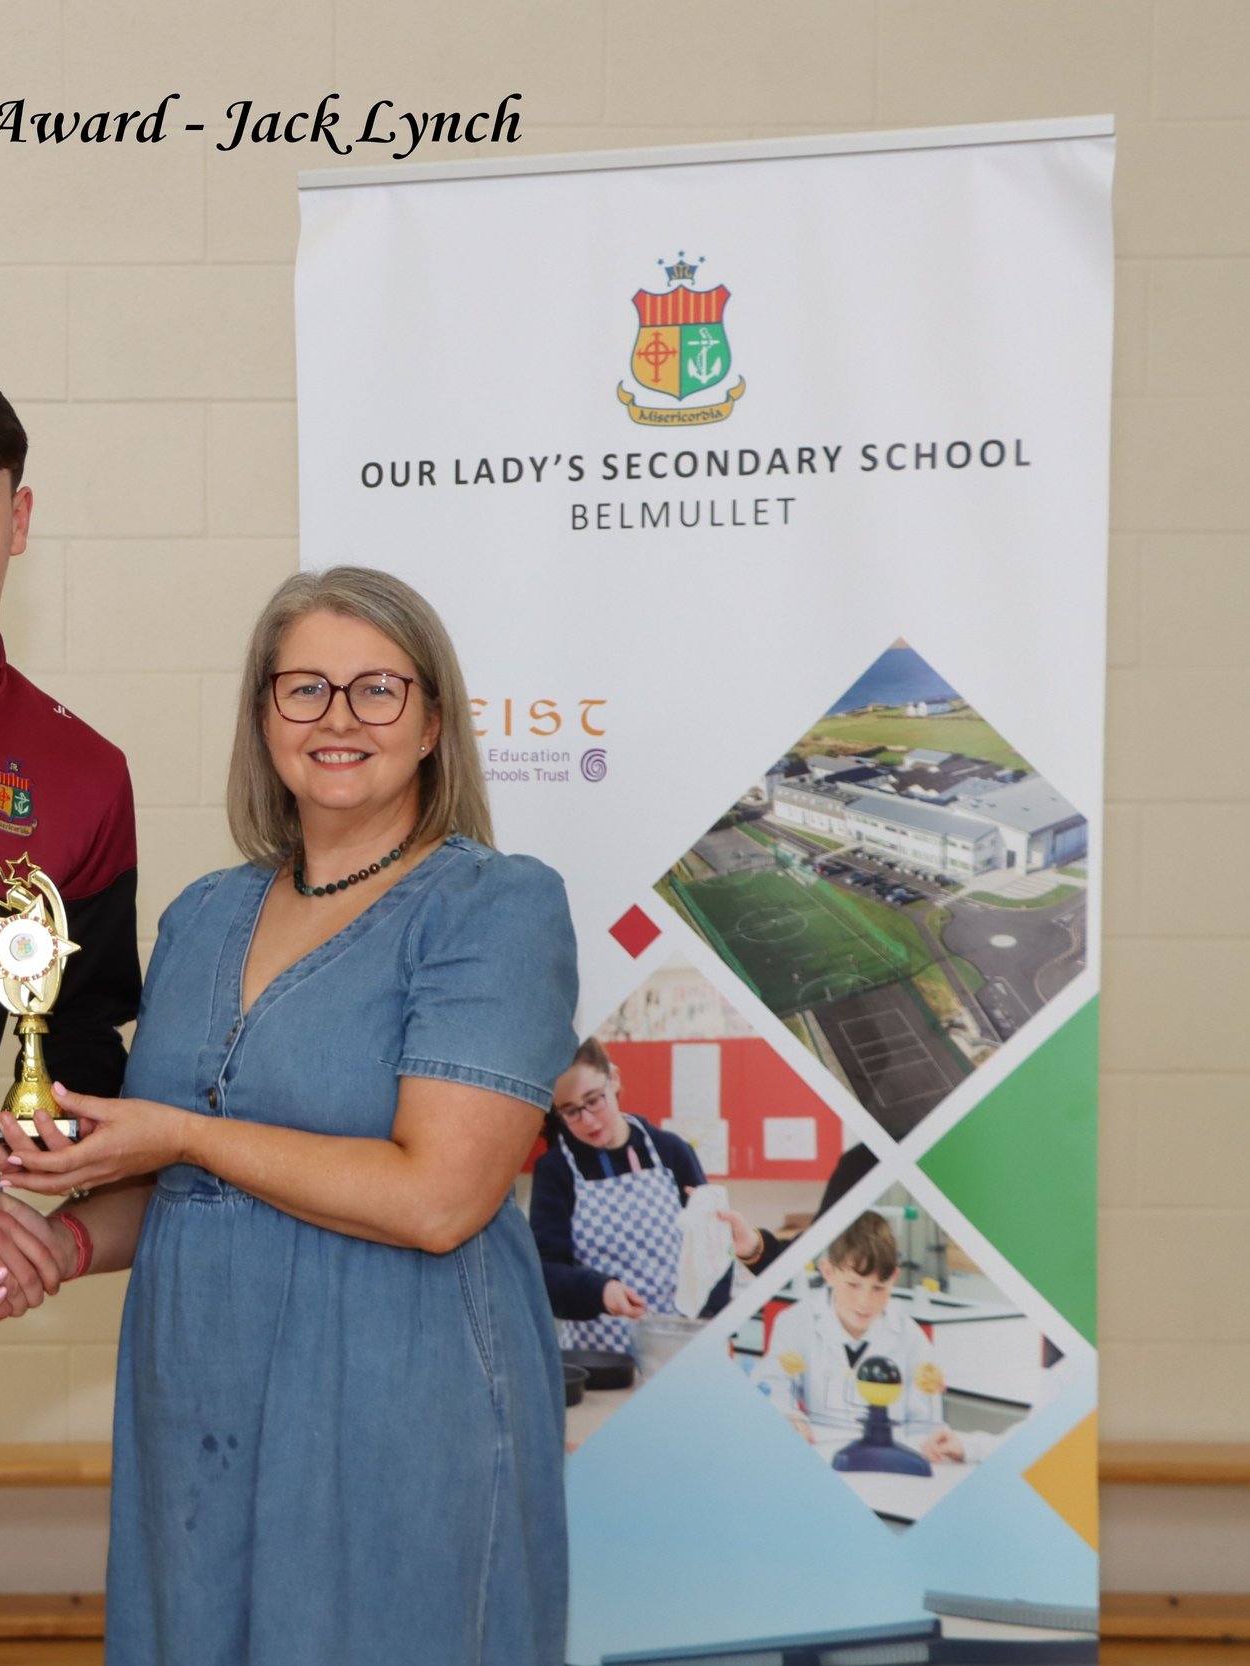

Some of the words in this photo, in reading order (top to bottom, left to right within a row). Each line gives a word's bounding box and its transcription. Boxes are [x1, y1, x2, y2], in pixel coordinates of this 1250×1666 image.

[638, 408, 723, 423] Misericordia
[361, 459, 437, 489] OUR
[602, 444, 842, 481] SECONDARY
[860, 438, 1031, 472] SCHOOL
[571, 497, 797, 531] BELMULLET
[488, 748, 571, 763] Education
[483, 768, 530, 782] chools
[534, 768, 570, 782] Trust
